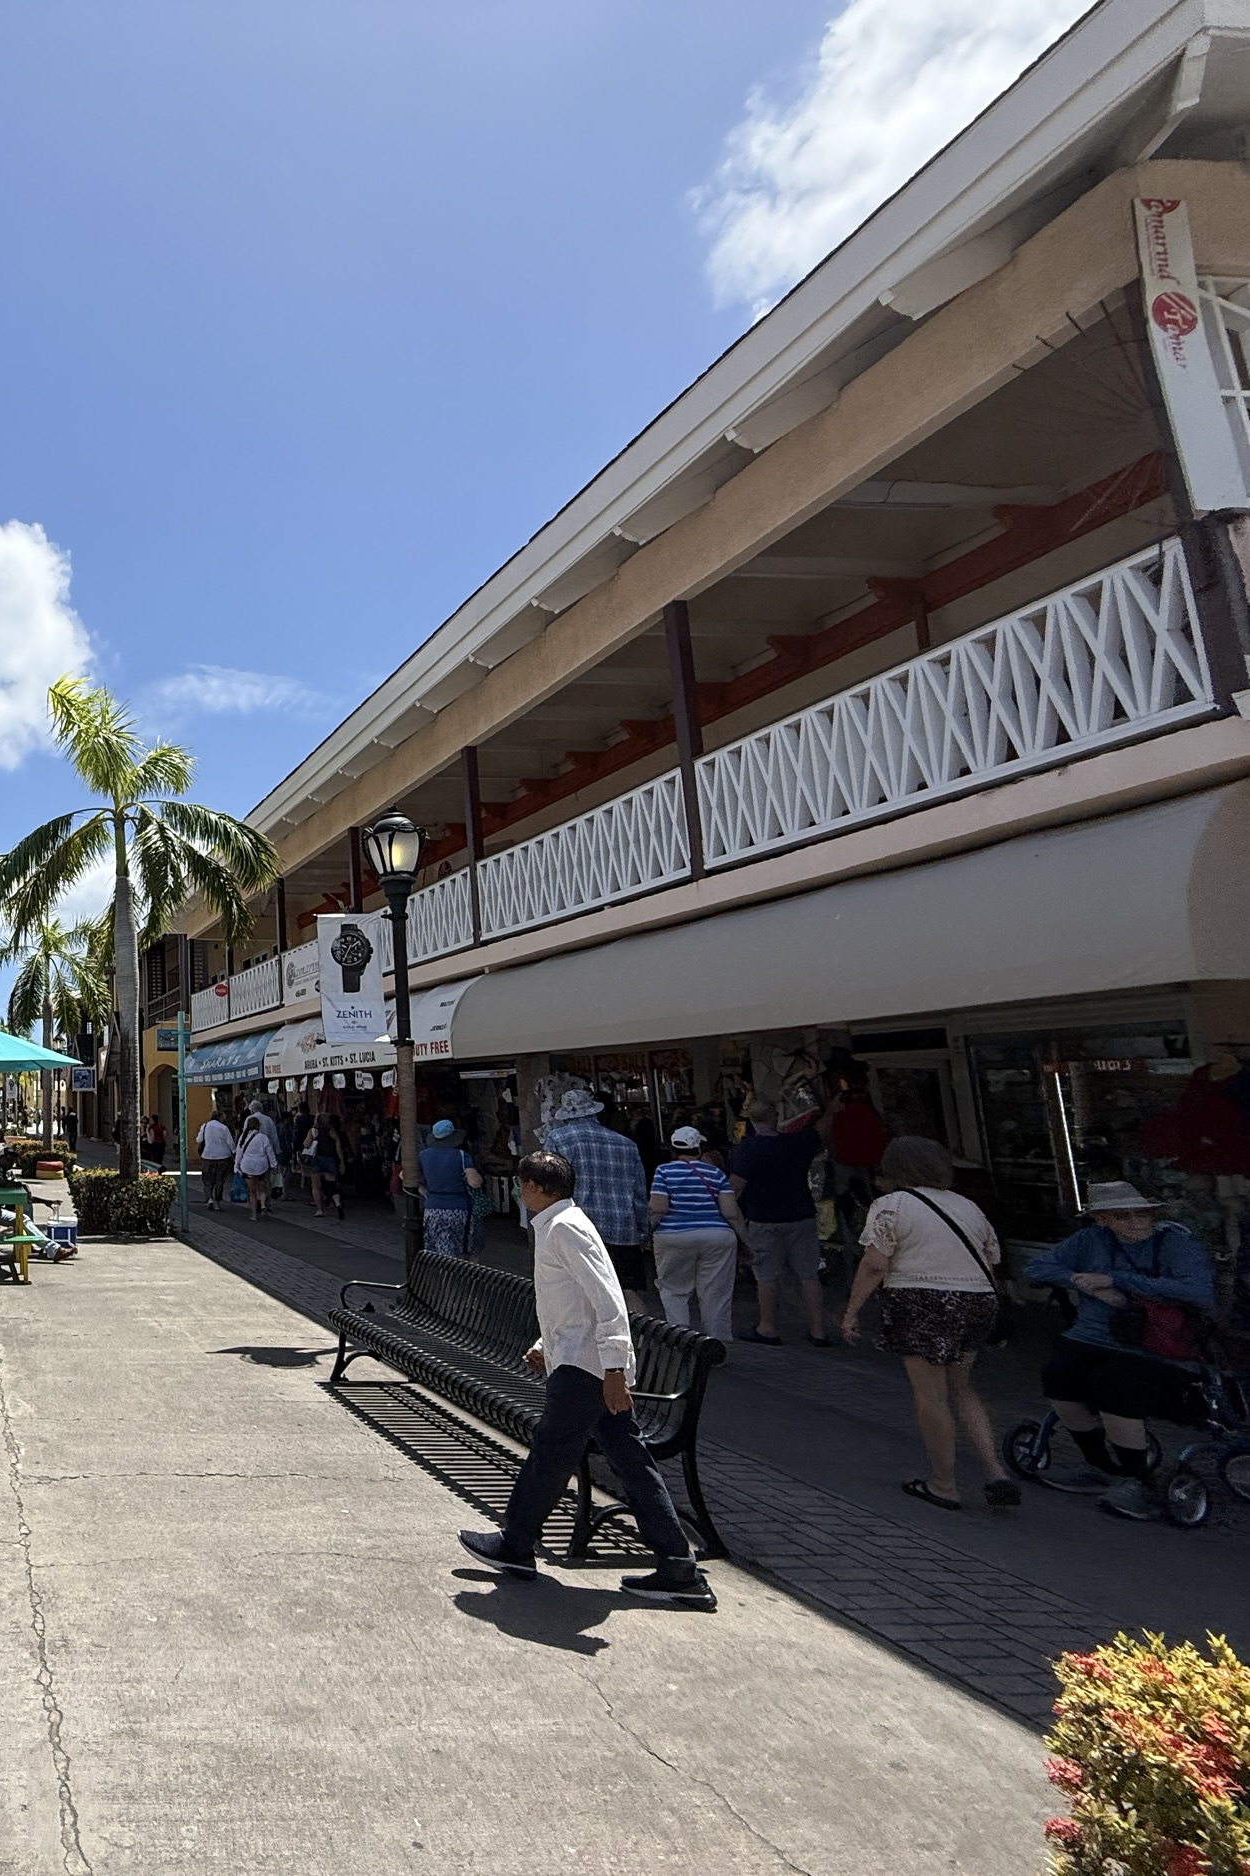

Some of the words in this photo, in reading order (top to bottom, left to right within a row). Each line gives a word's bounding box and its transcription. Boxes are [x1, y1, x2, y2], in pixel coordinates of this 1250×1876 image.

[336, 1010, 372, 1018] ZENITH
[430, 1040, 449, 1055] FREE
[330, 1055, 344, 1066] KITTS
[359, 1051, 376, 1063] LUCIA
